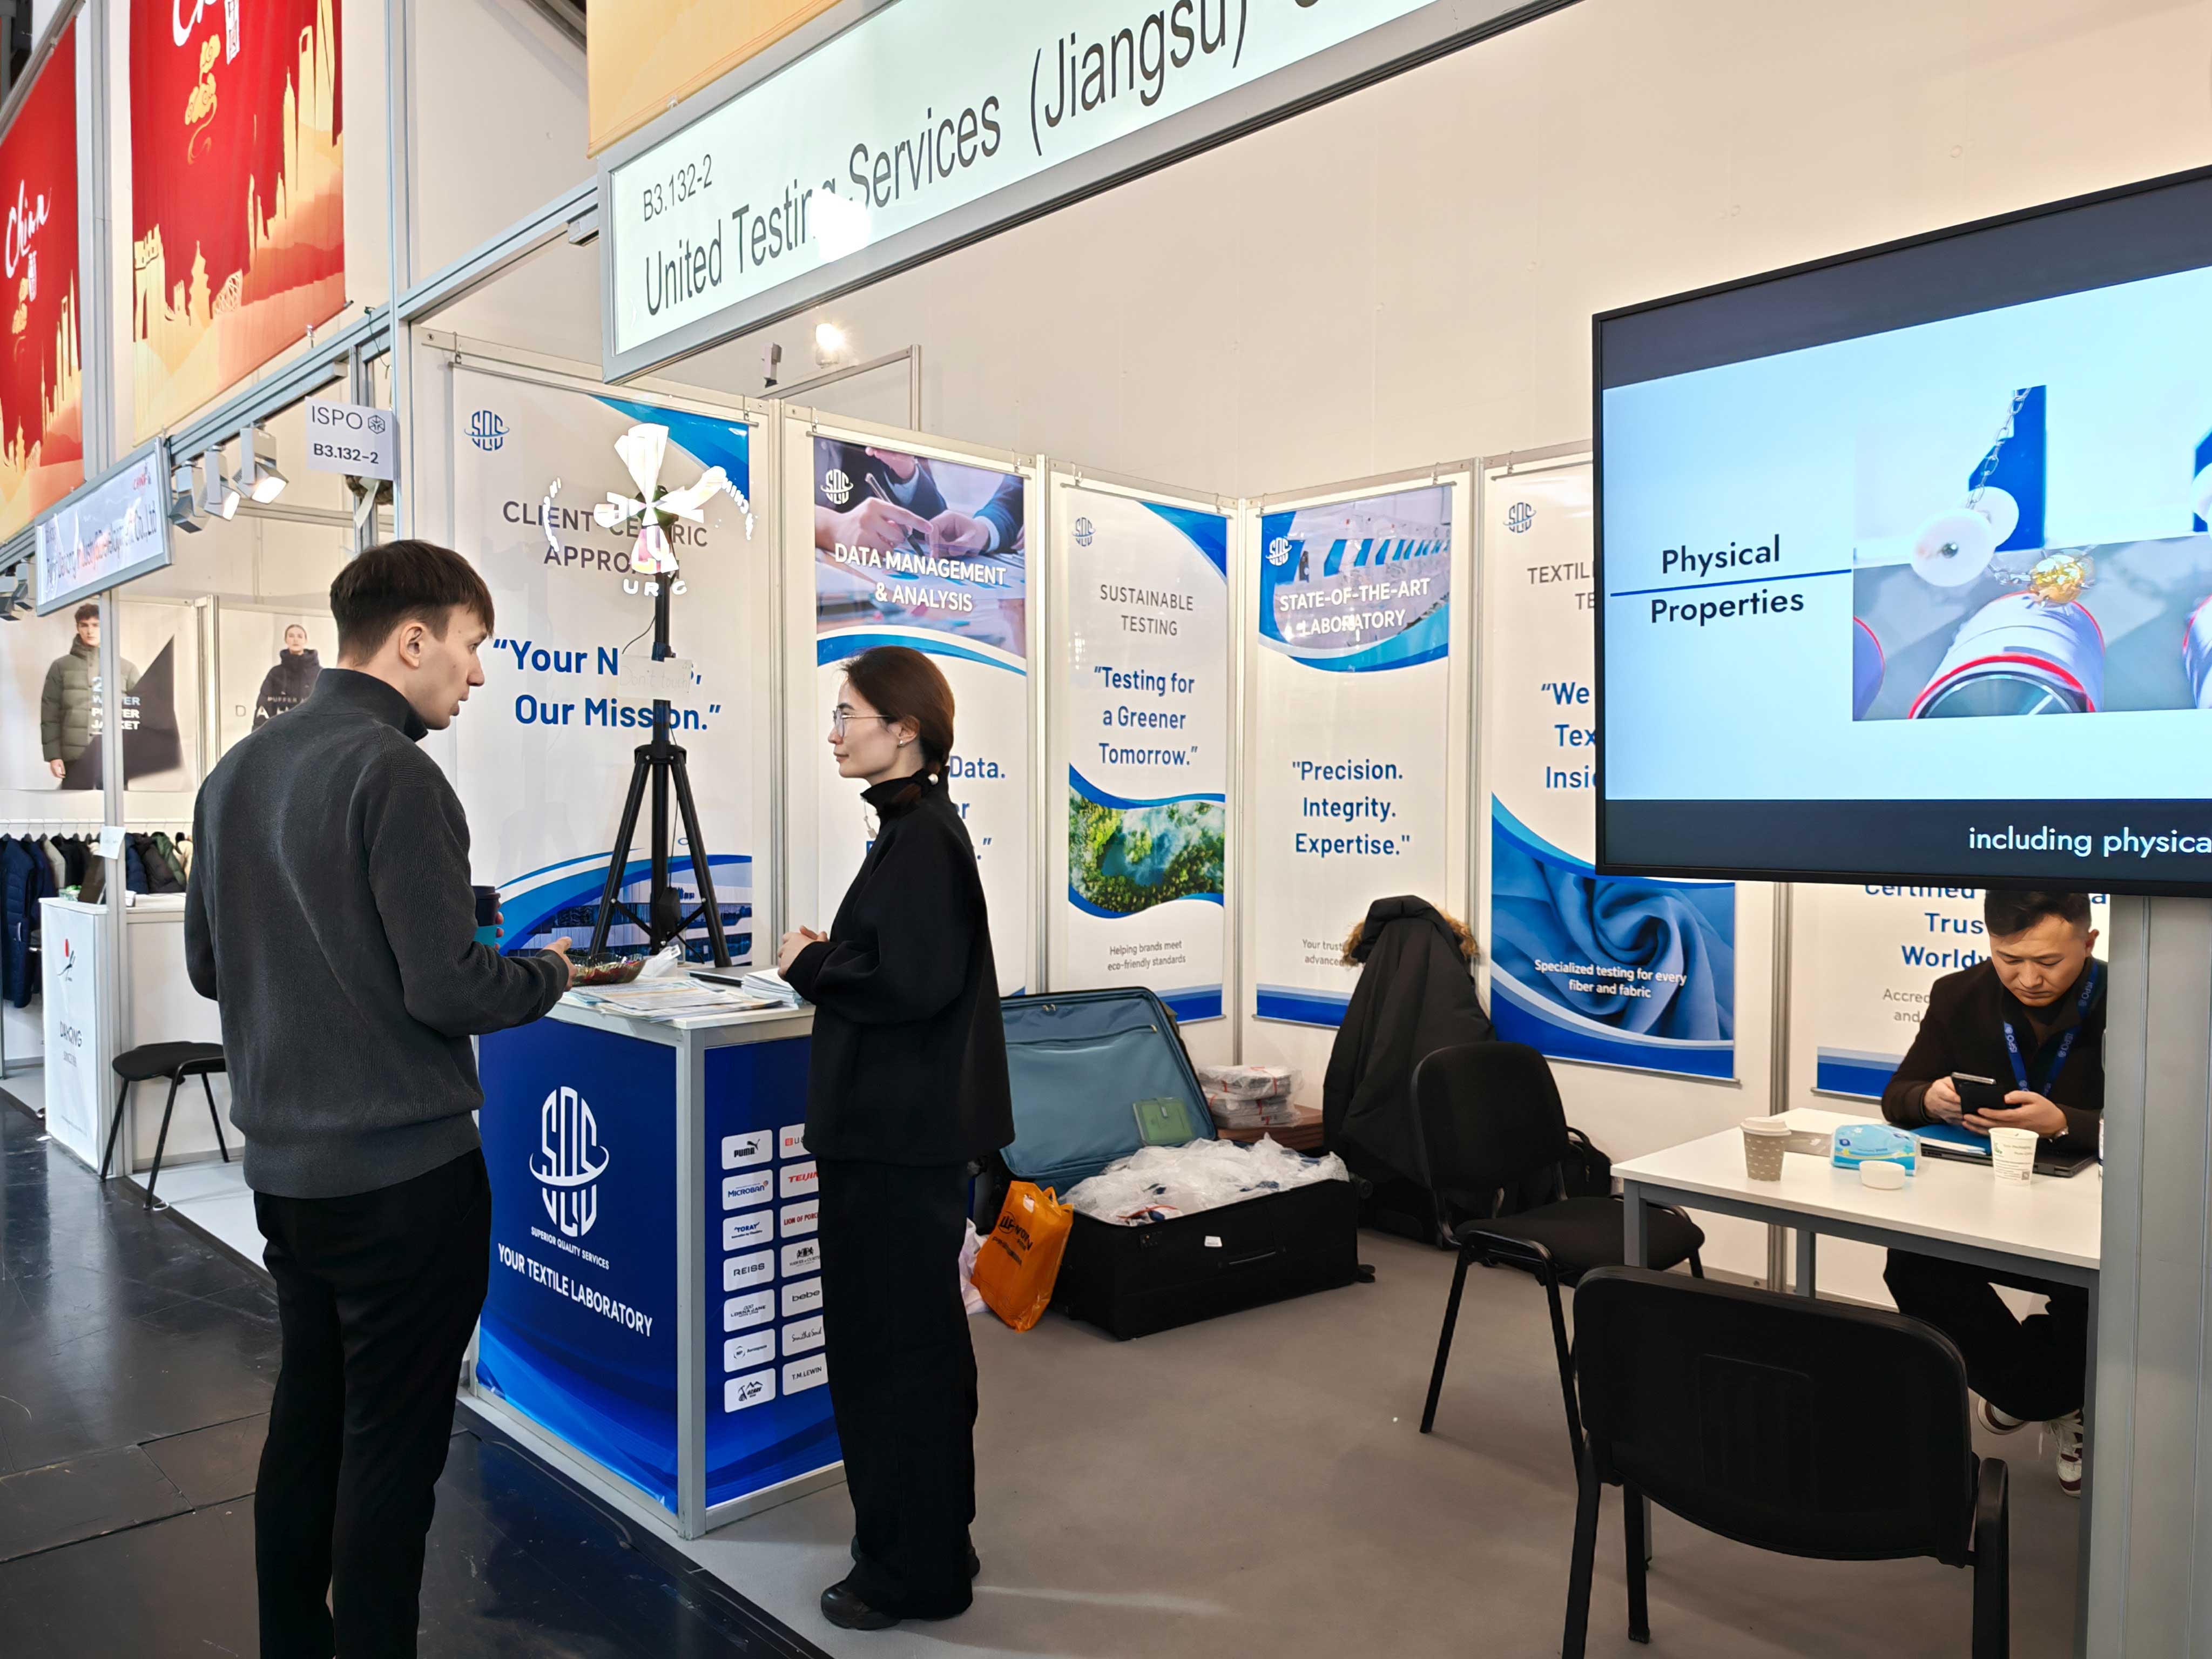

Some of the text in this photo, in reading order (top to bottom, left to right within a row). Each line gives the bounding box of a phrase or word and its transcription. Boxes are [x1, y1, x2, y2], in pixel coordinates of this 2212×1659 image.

[645, 0, 1247, 316] United Testi Services (Jiangsu)
[644, 154, 712, 222] B3.132-2
[311, 406, 363, 430] ISPO
[313, 443, 379, 464] B3.132-2
[834, 543, 1007, 585] DATA MANAGEMENT
[1662, 533, 1780, 577] Physical
[1527, 563, 1595, 585] TEXTIL
[875, 582, 973, 612] & ANALYSIS
[1100, 584, 1194, 611] SUSTAINABLE
[1279, 577, 1430, 612] STATE-OF-THE-ART
[1651, 589, 1804, 626] Properties
[1121, 615, 1178, 636] TESTING
[1302, 609, 1406, 636] LABORATORY
[1171, 672, 1195, 694] for
[515, 694, 721, 730] Our Misson.”
[1103, 705, 1186, 730] a Greener
[1303, 797, 1397, 823] Integrity.
[1969, 825, 2212, 858] including physica
[1925, 912, 1984, 934] Trus
[1109, 940, 1183, 956] Helping brands meet
[1302, 939, 1343, 951] Your trust
[1107, 954, 1186, 972] eco-friendly standards
[1535, 959, 1687, 986] Specialized testing for every
[1569, 980, 1651, 998] fiber and fabric
[1894, 1010, 1920, 1022] and
[734, 1147, 754, 1157] PUMA
[734, 1222, 760, 1232] TORAY
[784, 1217, 795, 1225] LION
[531, 1226, 609, 1270] SUPERIOR QUALITY SERVICES
[733, 1263, 765, 1276] REISS
[498, 1243, 652, 1337] YOUR TEXTILE LABORATORY
[792, 1290, 820, 1302] bebe
